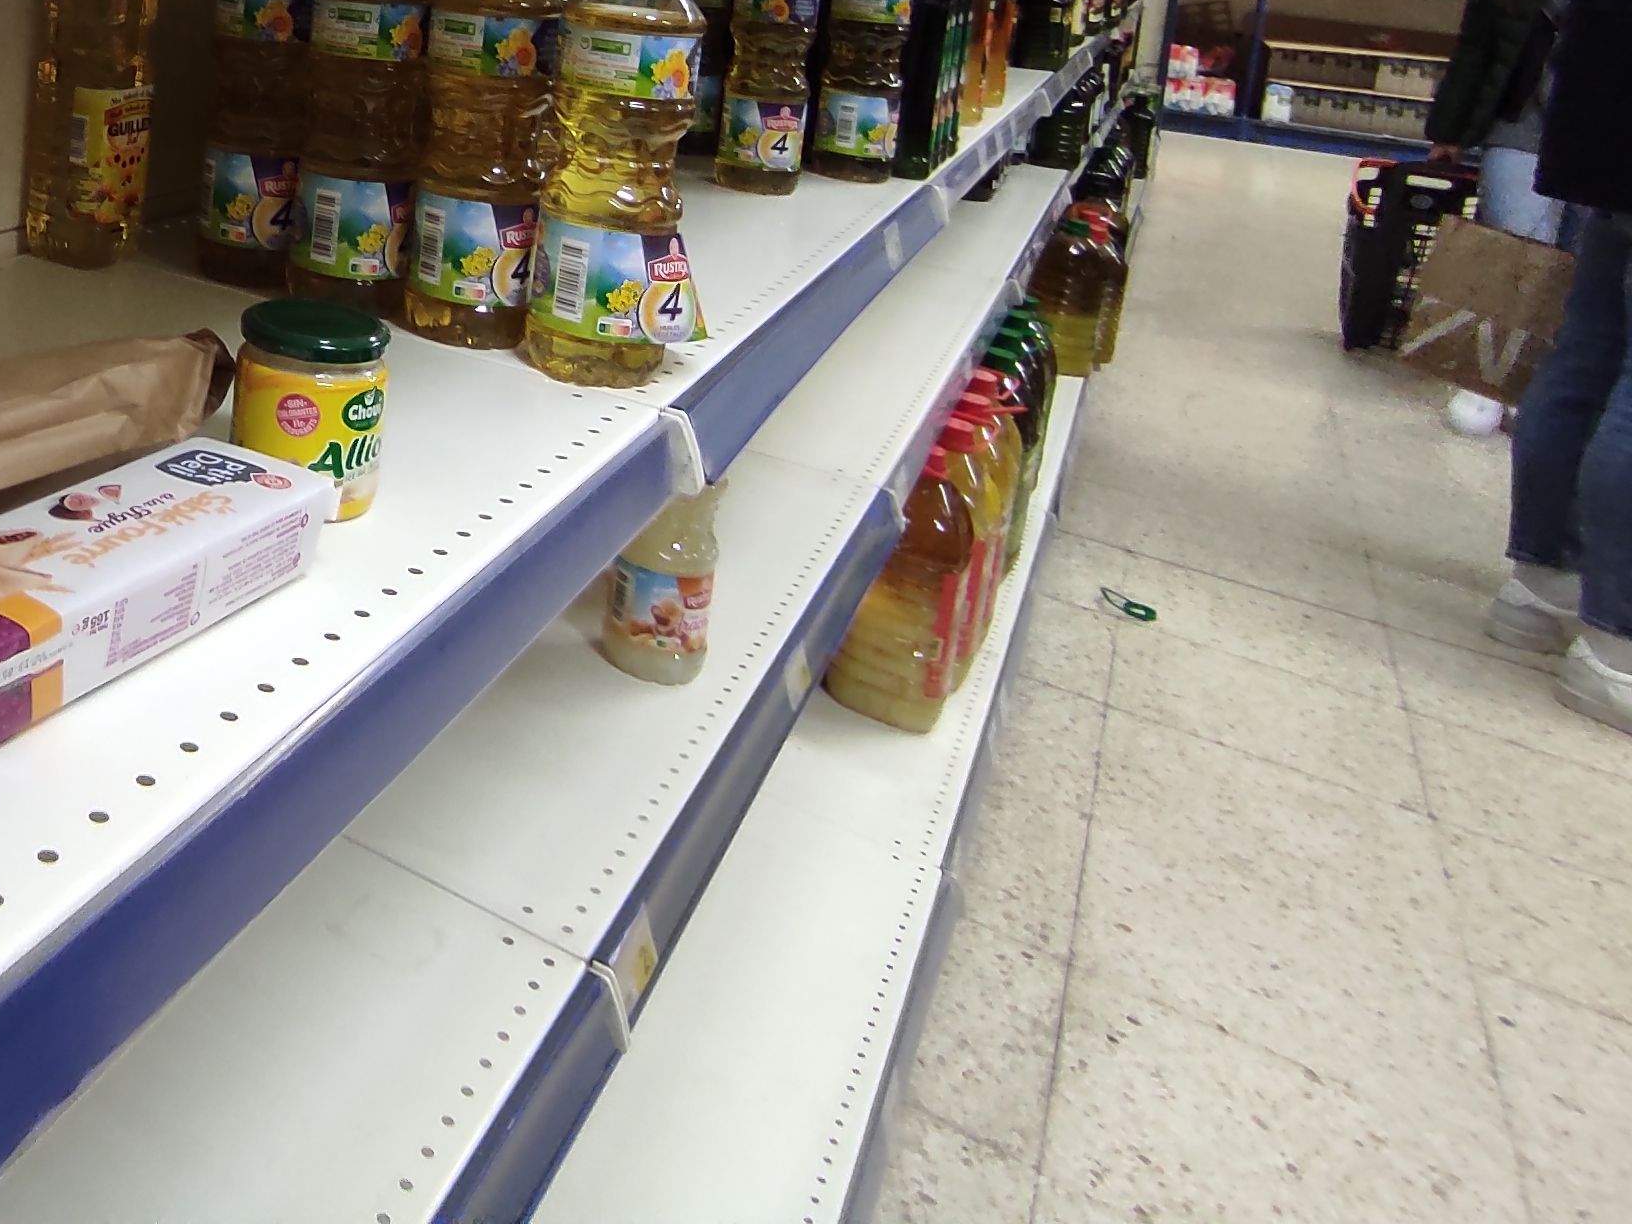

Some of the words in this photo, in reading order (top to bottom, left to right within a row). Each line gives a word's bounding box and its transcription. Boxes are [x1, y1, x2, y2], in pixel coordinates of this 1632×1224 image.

[771, 133, 789, 155] 4
[271, 203, 293, 231] 4
[658, 283, 683, 321] 4
